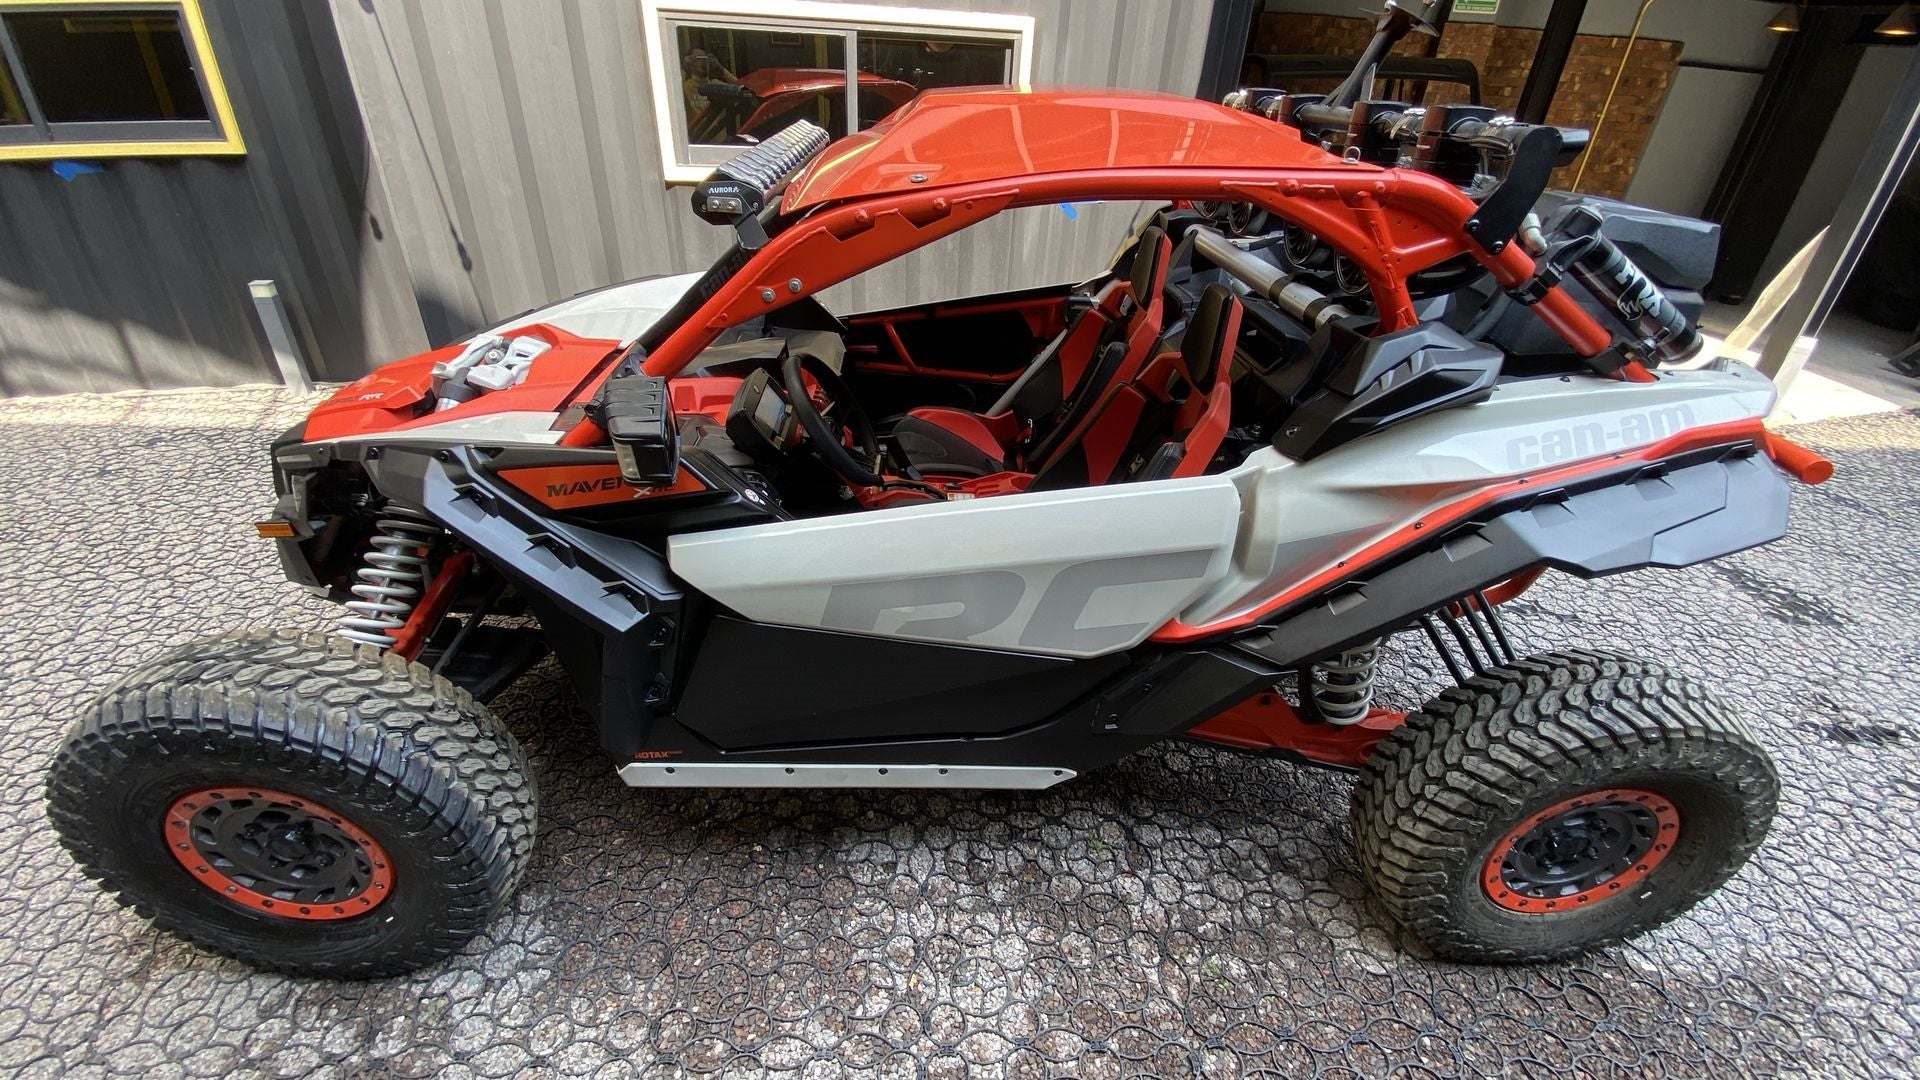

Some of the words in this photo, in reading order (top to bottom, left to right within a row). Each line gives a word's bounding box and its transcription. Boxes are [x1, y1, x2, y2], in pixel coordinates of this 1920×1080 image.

[708, 186, 740, 194] AURORA
[1506, 404, 1697, 470] can-am
[634, 751, 669, 759] ROTAX
